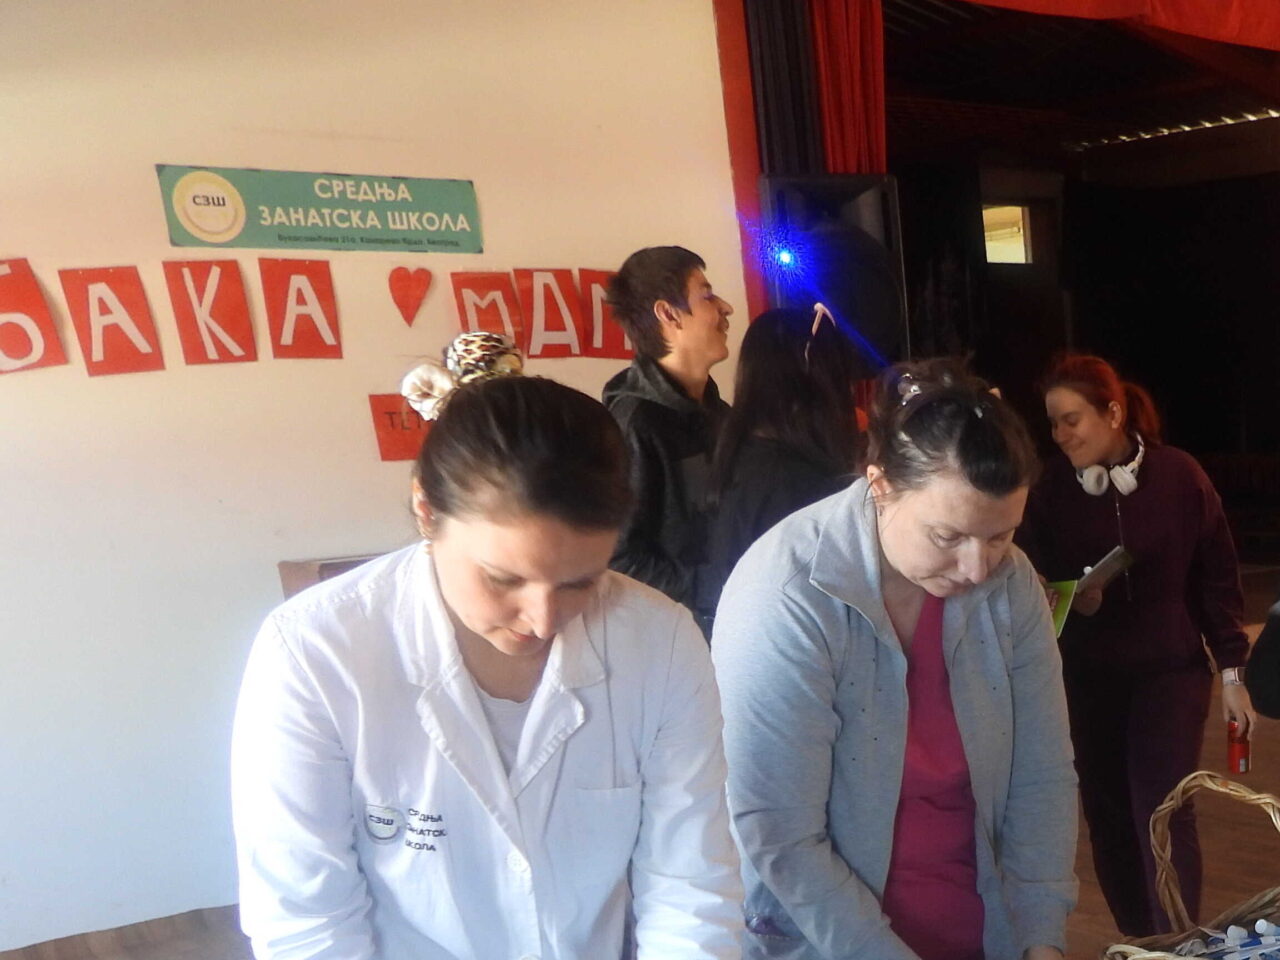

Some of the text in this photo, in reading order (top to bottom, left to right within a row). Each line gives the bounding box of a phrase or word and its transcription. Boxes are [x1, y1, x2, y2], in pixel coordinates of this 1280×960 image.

[192, 195, 227, 208] СЗШ
[313, 178, 413, 203] СРЕДЊА
[259, 205, 472, 232] ЗАНАТСКА ШКОЛА
